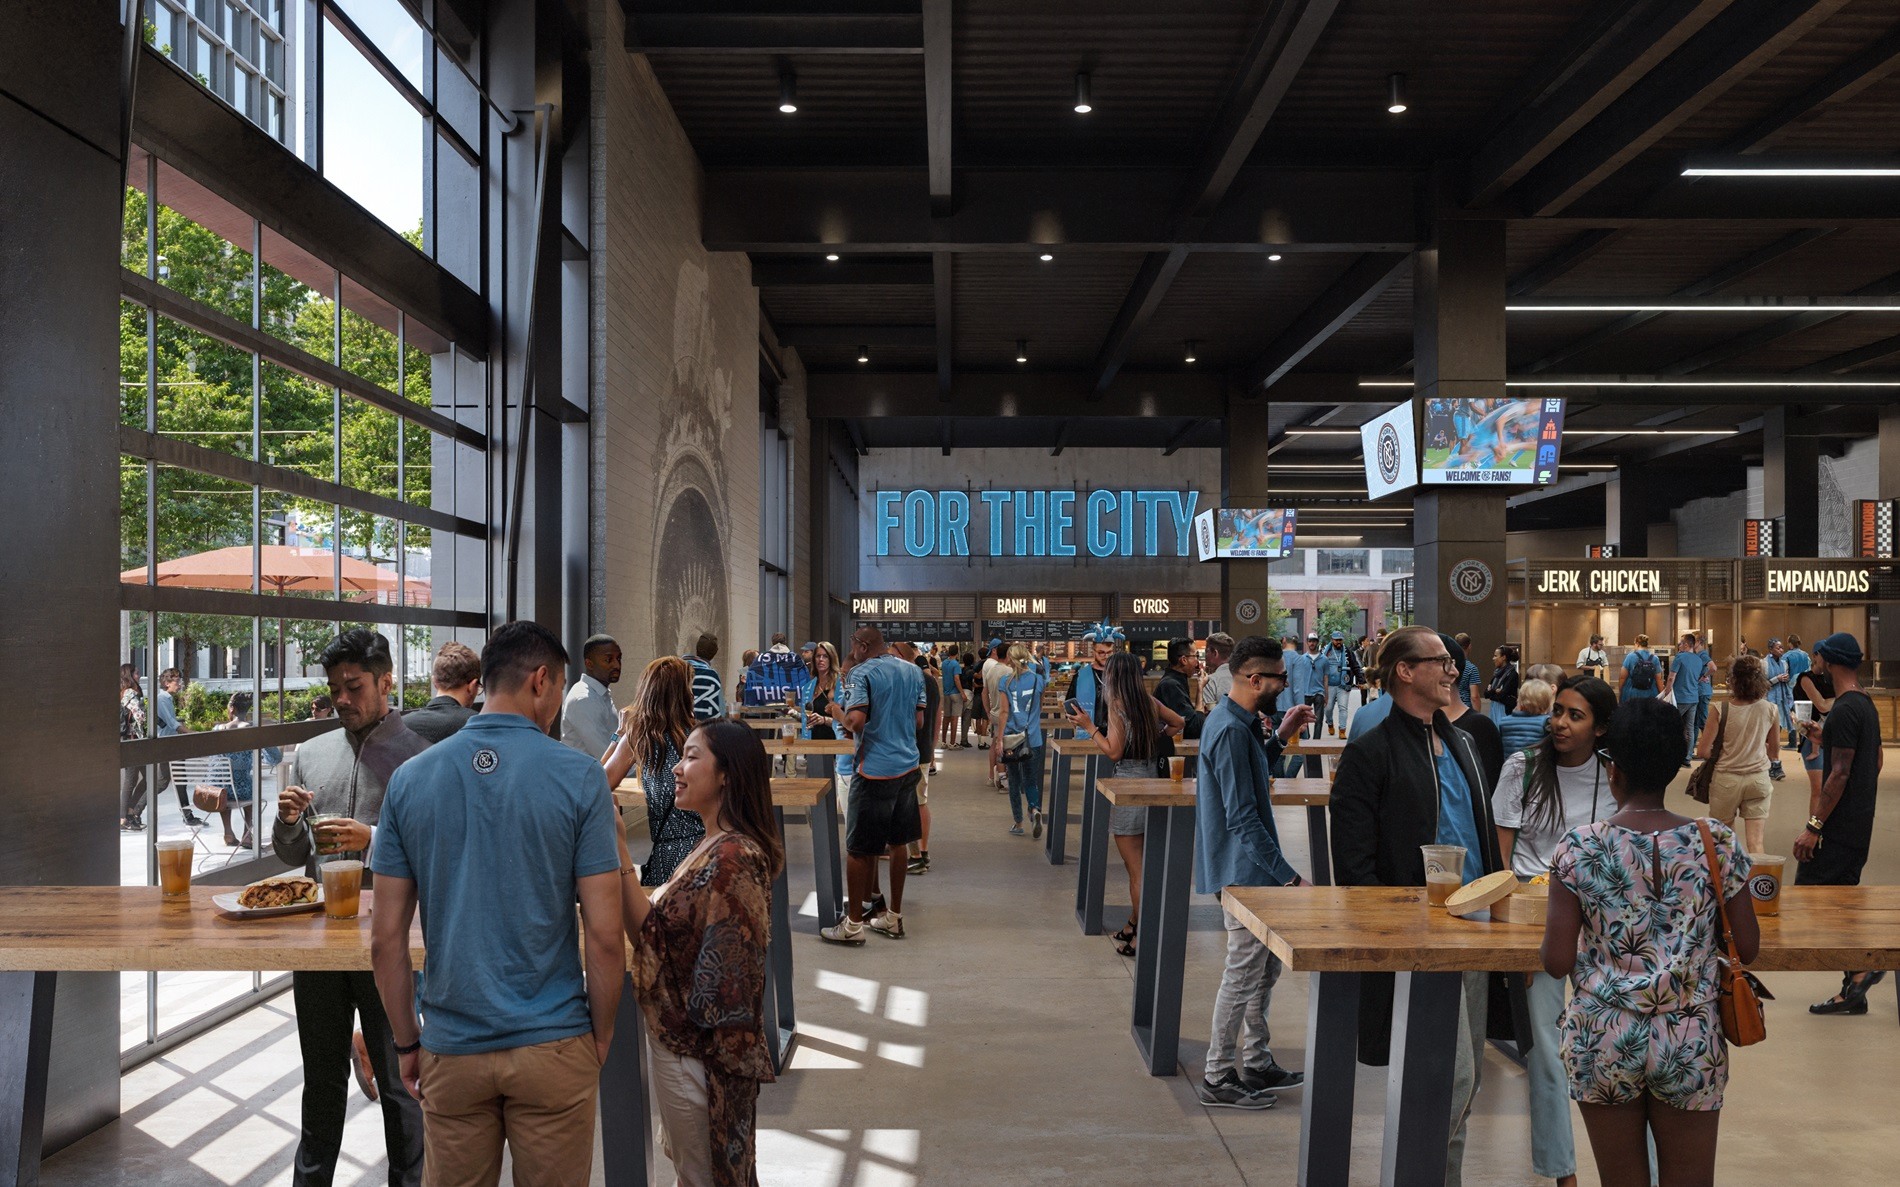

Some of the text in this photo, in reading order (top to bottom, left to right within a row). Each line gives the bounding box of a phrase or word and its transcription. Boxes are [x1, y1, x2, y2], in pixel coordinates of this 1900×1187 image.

[1446, 471, 1512, 481] WELCOME FANS!
[876, 489, 970, 557] FOR
[981, 490, 1076, 556] THE
[1087, 489, 1199, 557] CITY
[1862, 502, 1875, 548] BROOKLYN
[1746, 521, 1758, 550] STATEN
[1462, 560, 1480, 568] YORK
[1480, 565, 1491, 577] CITY
[1538, 570, 1660, 592] JERK CHICKEN
[1767, 570, 1869, 592] EMPANADAS
[852, 599, 909, 613] PANI PURI
[997, 599, 1046, 613] BANH MI
[1133, 599, 1170, 613] GYROS
[757, 652, 797, 662] IS MY
[752, 686, 790, 700] THIS
[1011, 688, 1034, 713] 17
